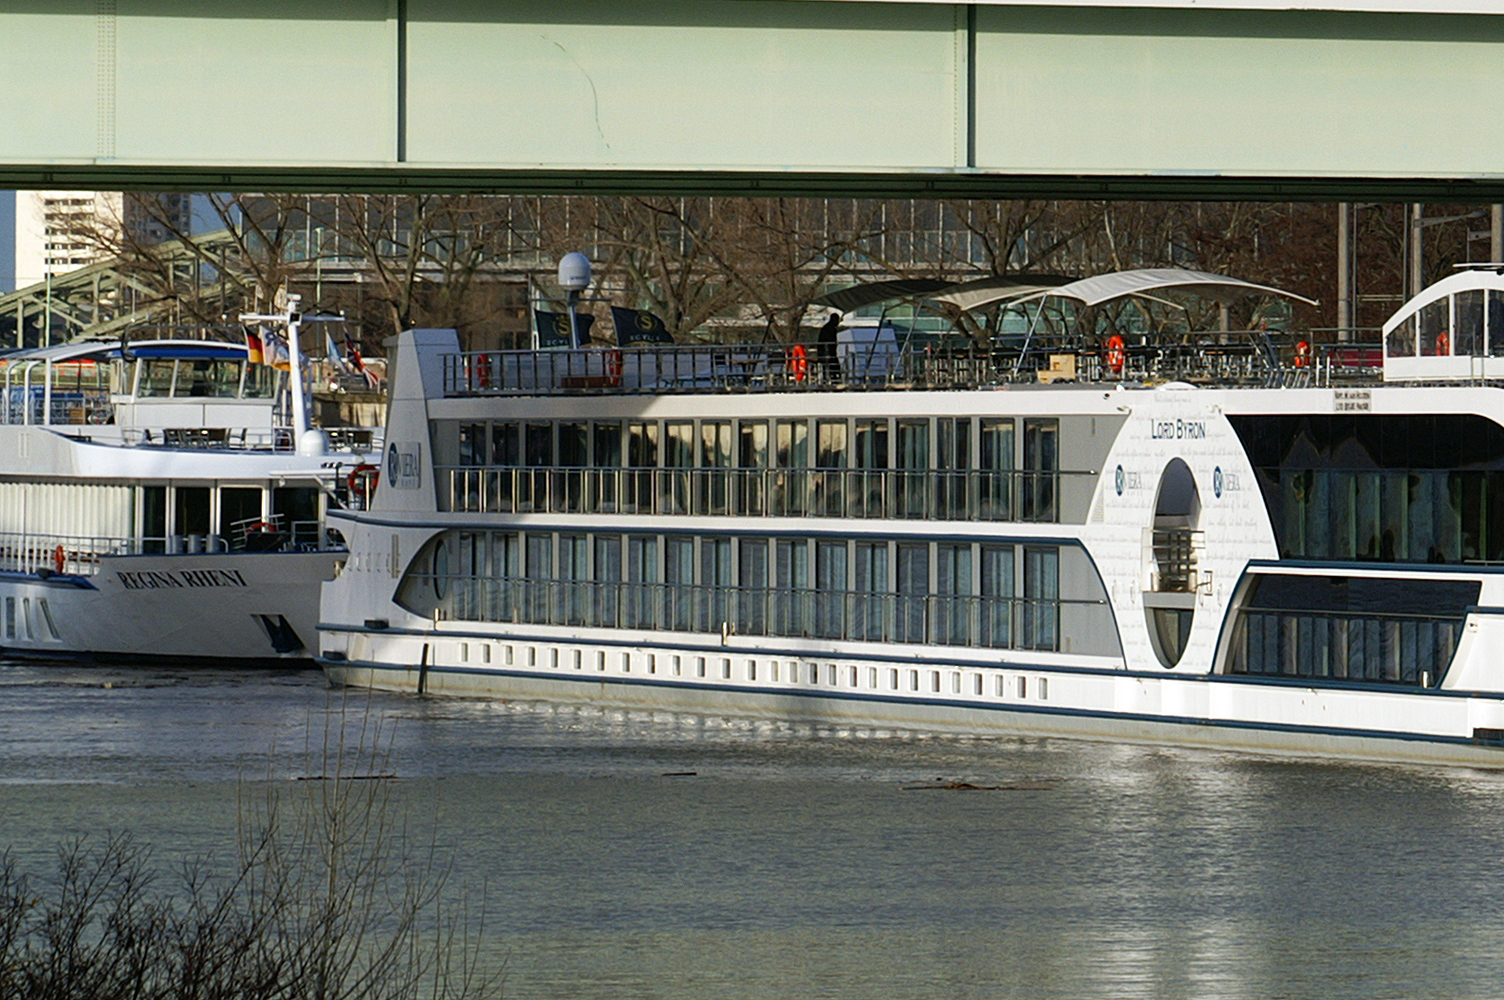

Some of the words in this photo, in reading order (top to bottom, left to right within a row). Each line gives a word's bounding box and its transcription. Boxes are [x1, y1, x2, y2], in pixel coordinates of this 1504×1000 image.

[1151, 419, 1174, 439] LORD
[1177, 419, 1206, 439] BYRON
[116, 571, 184, 589] REGINA
[180, 570, 247, 587] RHENI
